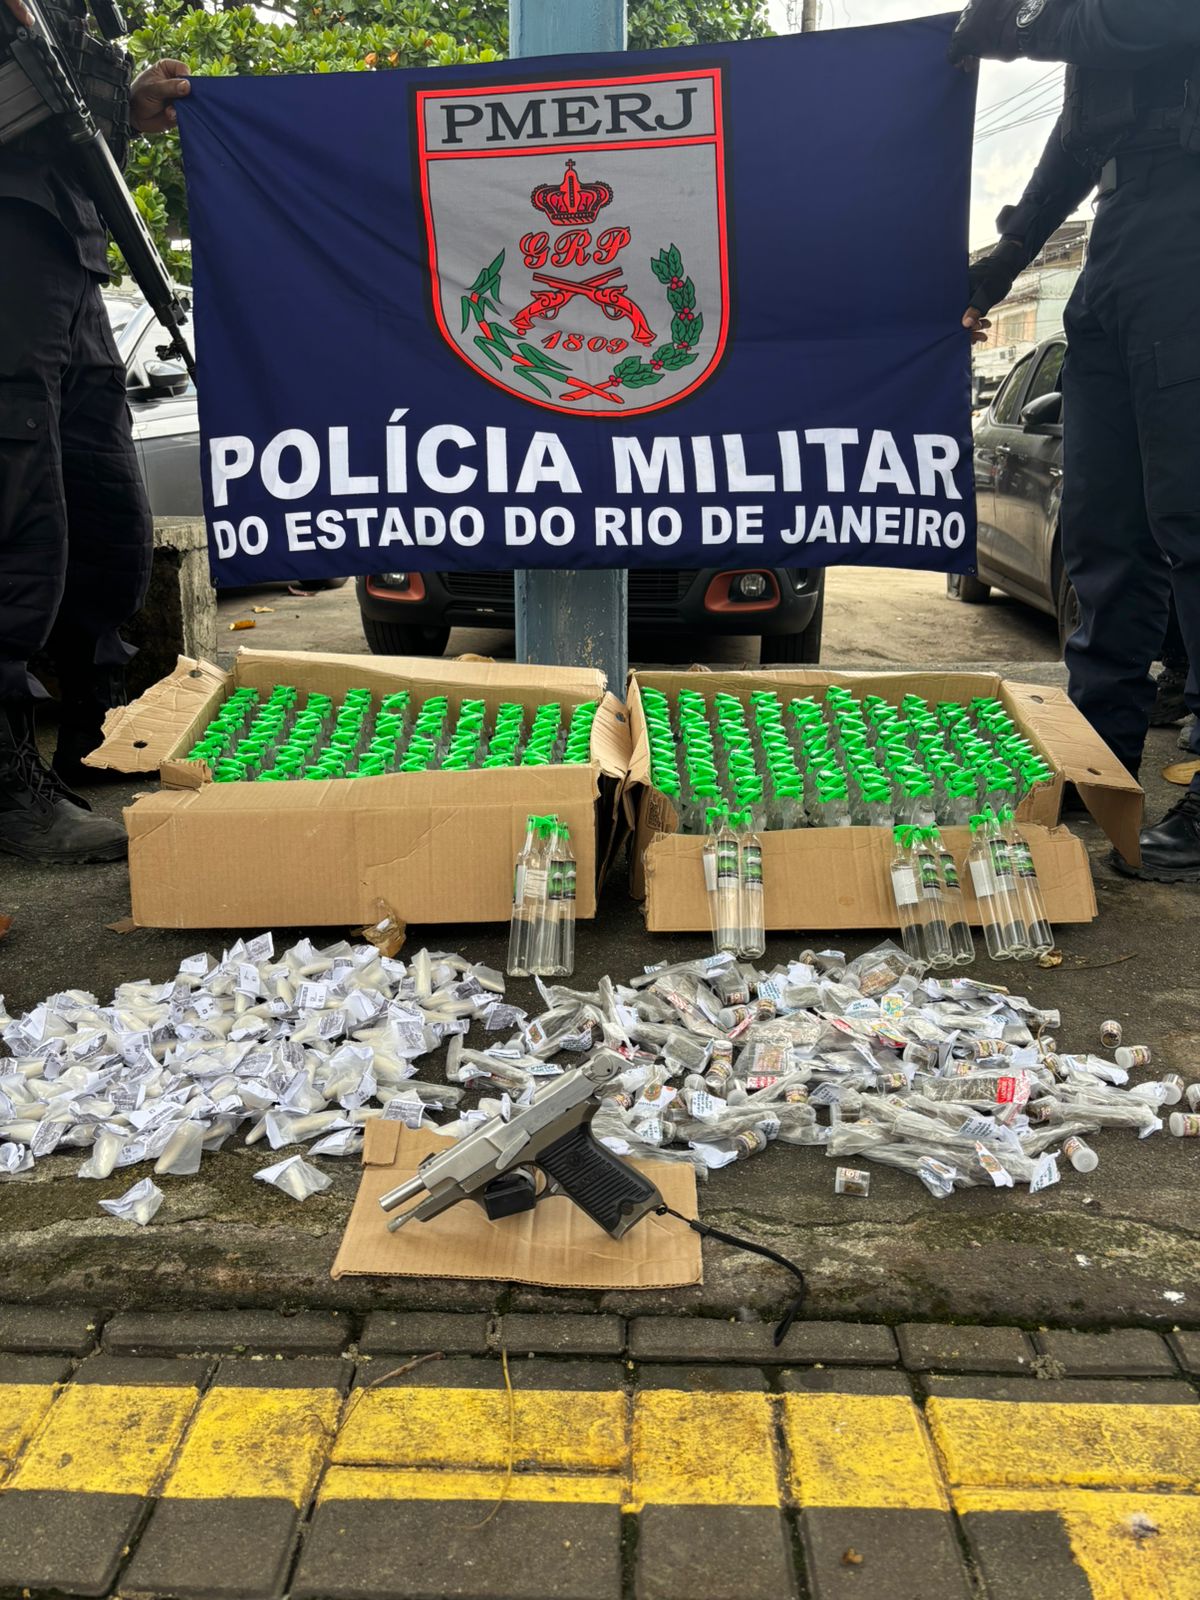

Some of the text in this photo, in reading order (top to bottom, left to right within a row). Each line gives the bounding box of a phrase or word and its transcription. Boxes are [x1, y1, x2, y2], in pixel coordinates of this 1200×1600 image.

[440, 87, 698, 145] PMERJ
[519, 226, 632, 269] GRP
[541, 330, 629, 355] 1809
[210, 408, 964, 508] POLÍCIA MILITAR
[213, 505, 967, 560] DO ESTADO DO RIO DE JANEIRO
